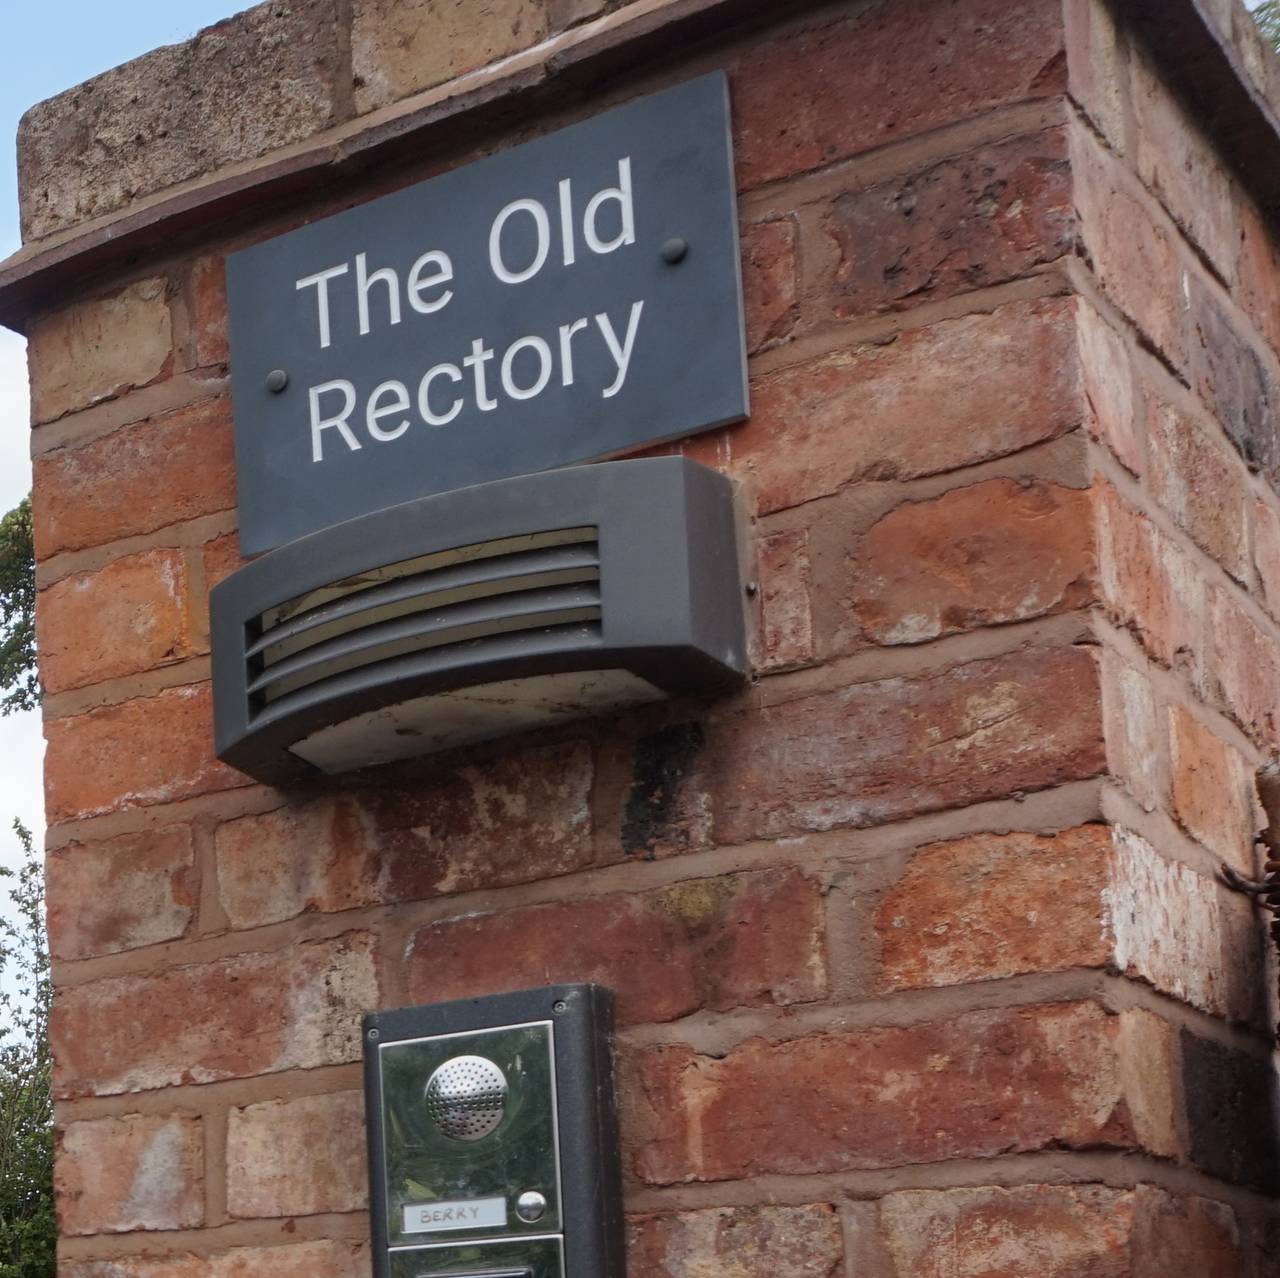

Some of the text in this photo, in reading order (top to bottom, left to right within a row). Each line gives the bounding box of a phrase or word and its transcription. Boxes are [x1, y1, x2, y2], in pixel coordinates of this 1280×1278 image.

[295, 156, 636, 349] The Old
[307, 300, 645, 464] Rectory
[419, 1206, 480, 1224] BERRY
